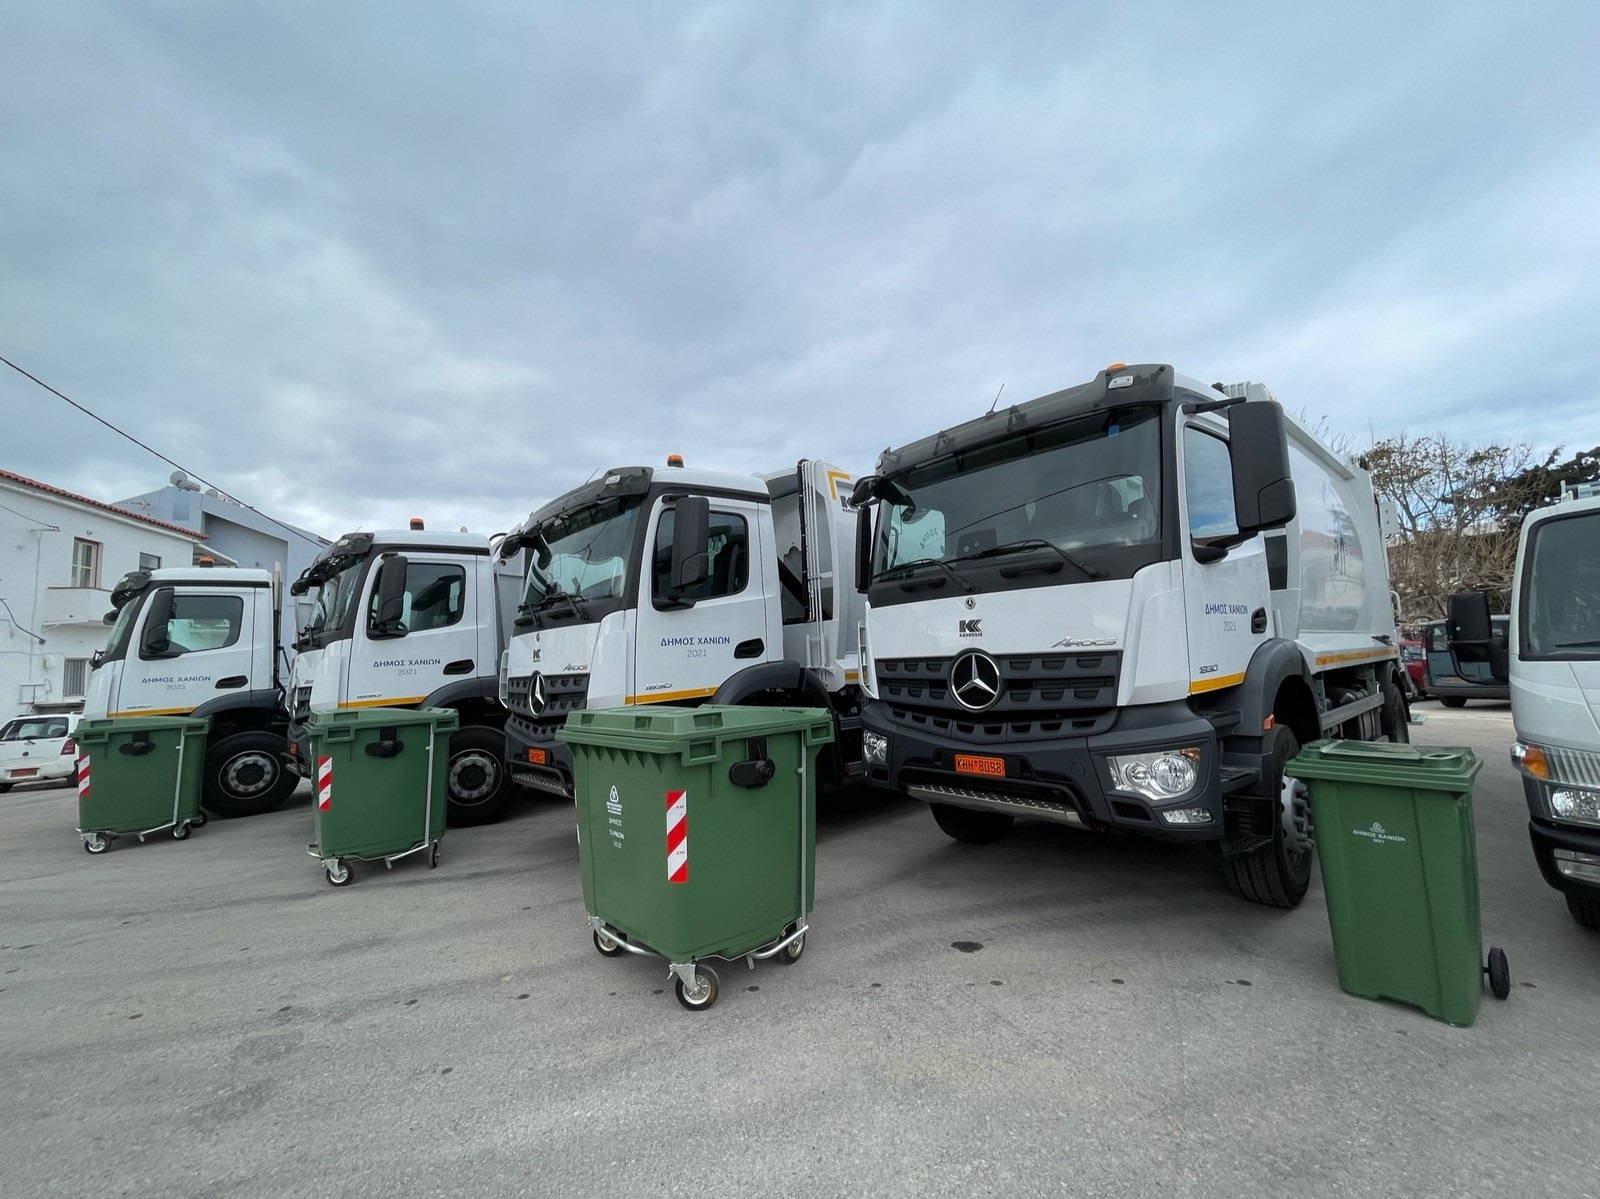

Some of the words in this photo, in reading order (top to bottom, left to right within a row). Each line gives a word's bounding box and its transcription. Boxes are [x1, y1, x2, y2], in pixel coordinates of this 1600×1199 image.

[1205, 604, 1227, 614] ΔΗΜΟΣ
[1228, 604, 1248, 614] ΧΑΝΙΩΝ
[1224, 621, 1237, 631] 2021
[660, 637, 695, 646] ΔΗΜΟΣ
[697, 636, 730, 645] ΧΑΝΙΩΝ
[687, 649, 707, 658] 2021
[141, 676, 175, 684] ΔΗΜΟΣ
[1352, 829, 1377, 838] ΔΗΜΟΣ
[1378, 833, 1406, 842] ΧΑΝΙΩΝ
